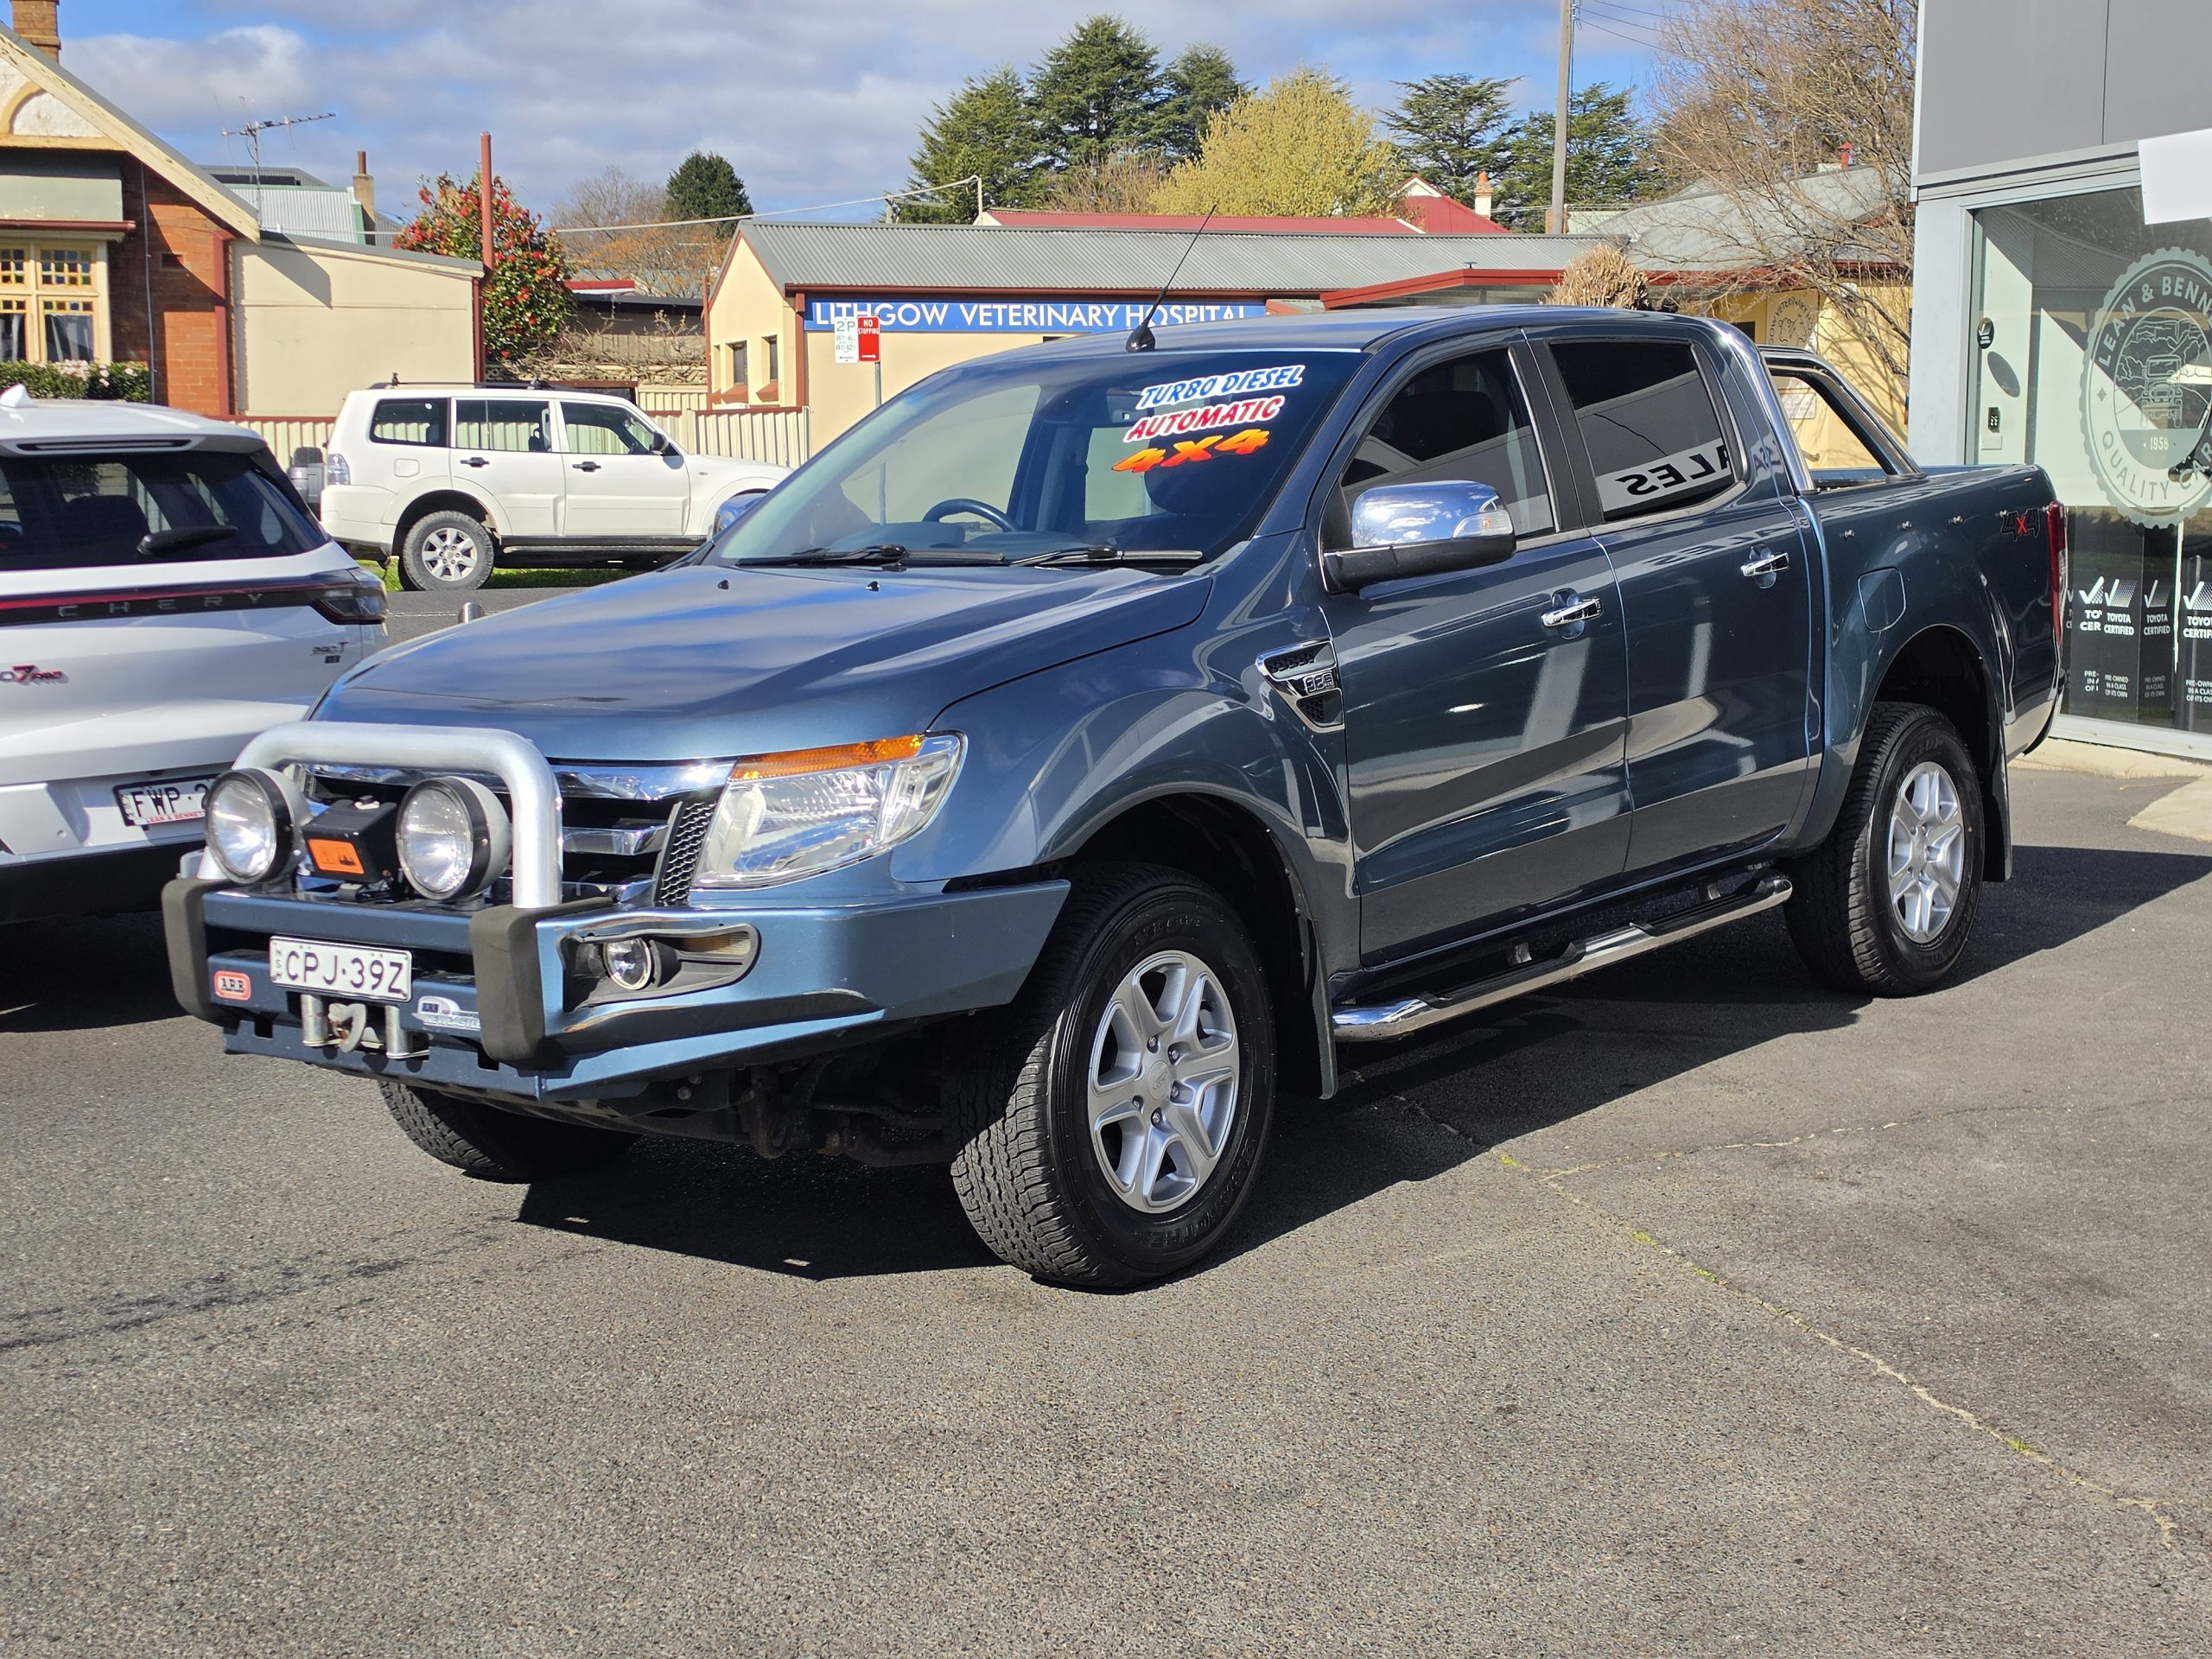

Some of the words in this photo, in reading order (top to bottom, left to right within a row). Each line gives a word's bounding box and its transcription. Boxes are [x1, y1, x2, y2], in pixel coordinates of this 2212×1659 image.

[816, 302, 949, 326] LITHGOW
[959, 304, 1120, 327] VETERINARY
[836, 321, 855, 332] 2P
[863, 319, 873, 327] NO
[2098, 296, 2136, 367] LEAN
[2141, 283, 2155, 303] &
[1140, 377, 1218, 408] TURBO
[1221, 366, 1303, 393] DIESEL
[1125, 397, 1283, 441] AUTOMATIC
[2102, 430, 2170, 500] QUALITY
[2179, 442, 2212, 490] CAR
[58, 593, 263, 617] CHERY
[2107, 612, 2132, 624] TOYOTA
[2146, 613, 2168, 624] TOYOTA
[2103, 624, 2134, 636] CERTIFIED
[2144, 625, 2171, 636] CERTIFIED
[2185, 678, 2212, 688] PRE-OWN
